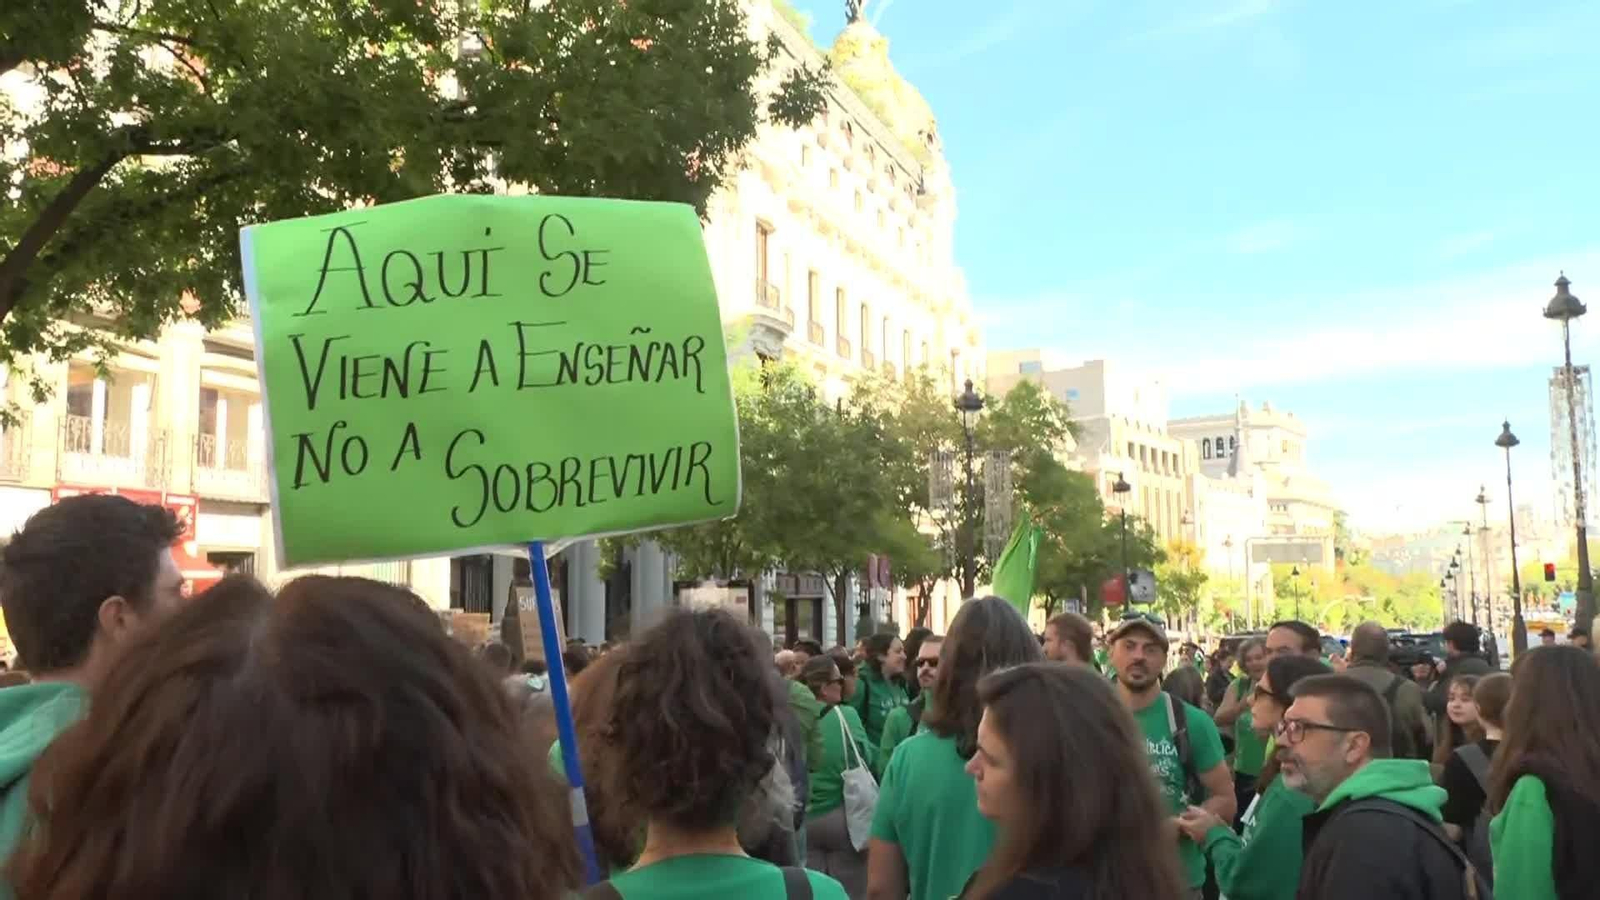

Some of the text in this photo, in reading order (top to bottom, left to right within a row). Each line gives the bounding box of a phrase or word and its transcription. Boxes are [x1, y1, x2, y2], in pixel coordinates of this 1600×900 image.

[538, 213, 611, 298] SE
[288, 320, 706, 411] VIENE A ENSEÑAR
[291, 420, 723, 529] NO A SOBREVIVIR
